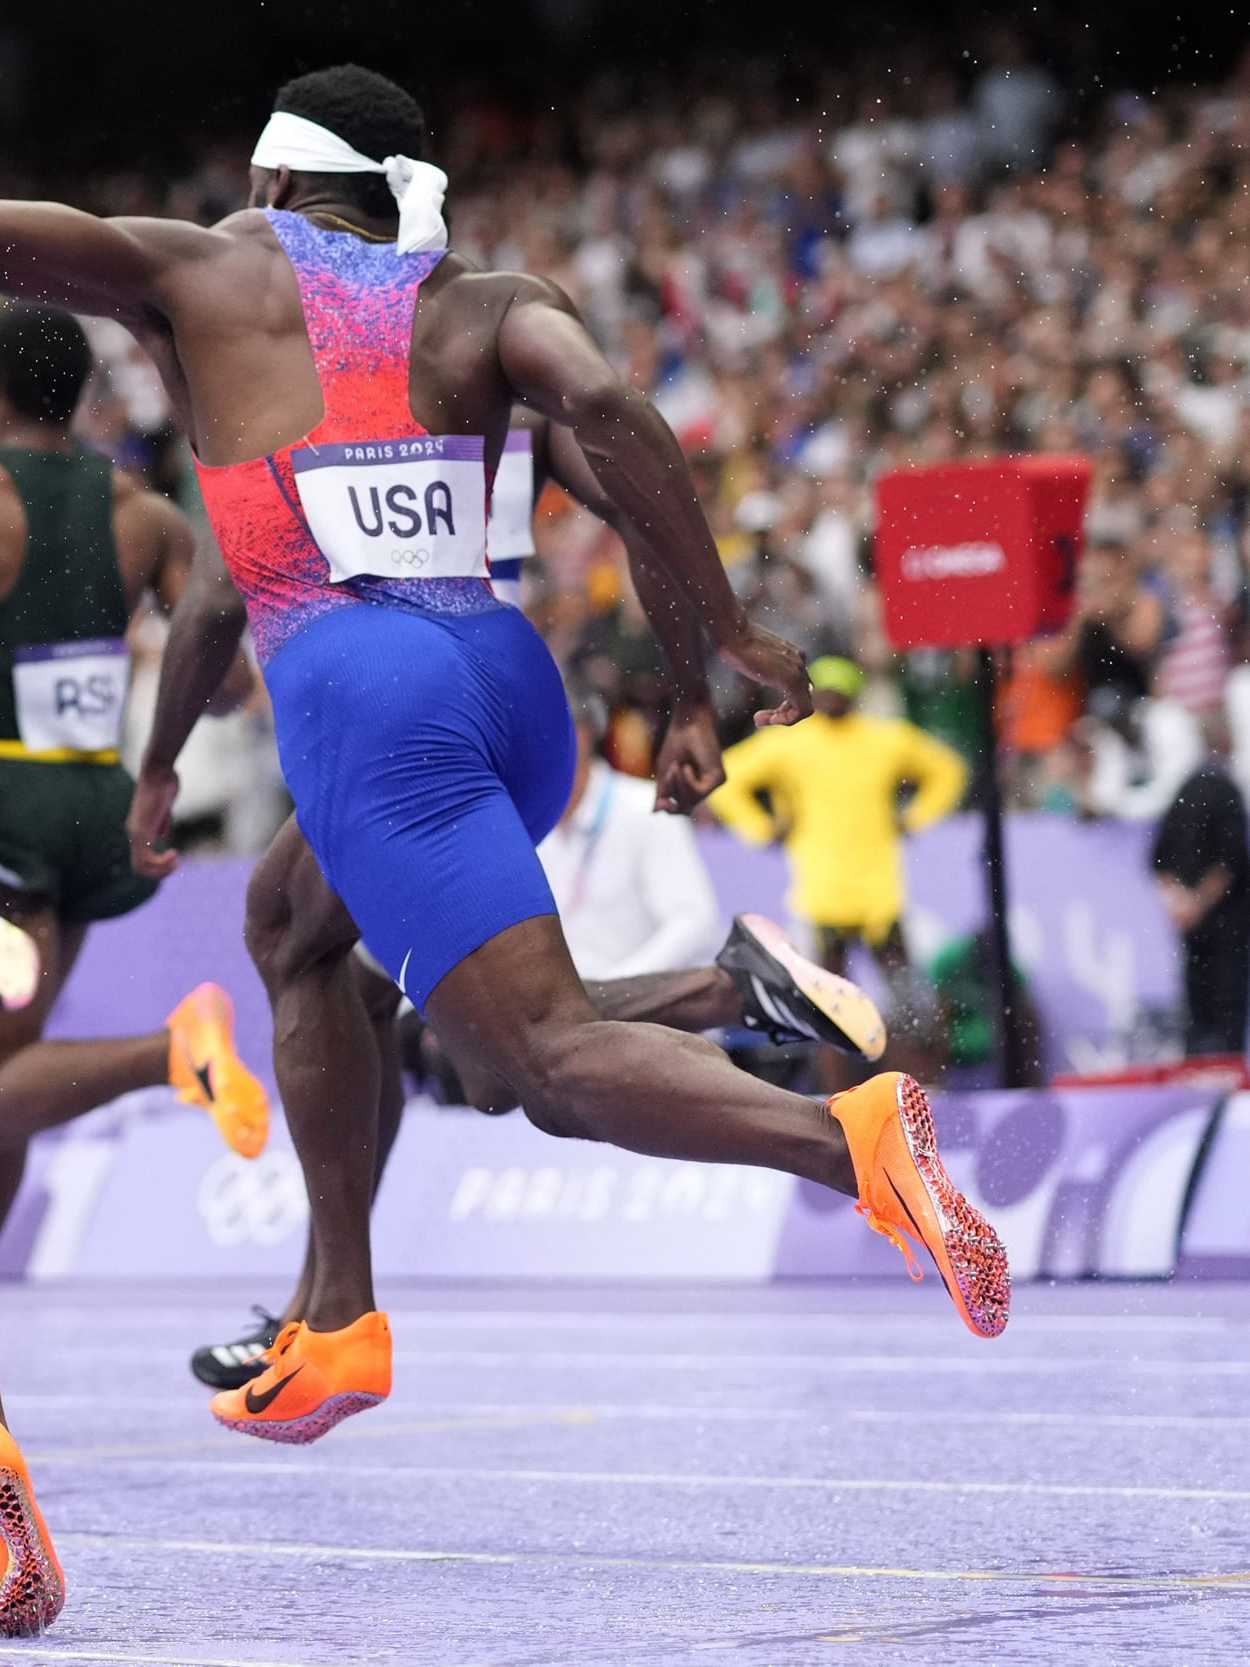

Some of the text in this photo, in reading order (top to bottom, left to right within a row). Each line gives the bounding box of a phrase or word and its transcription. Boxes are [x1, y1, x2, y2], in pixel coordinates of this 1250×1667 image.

[344, 439, 445, 461] PARIS 2024
[347, 480, 456, 538] USA
[451, 1166, 618, 1223] PARIS
